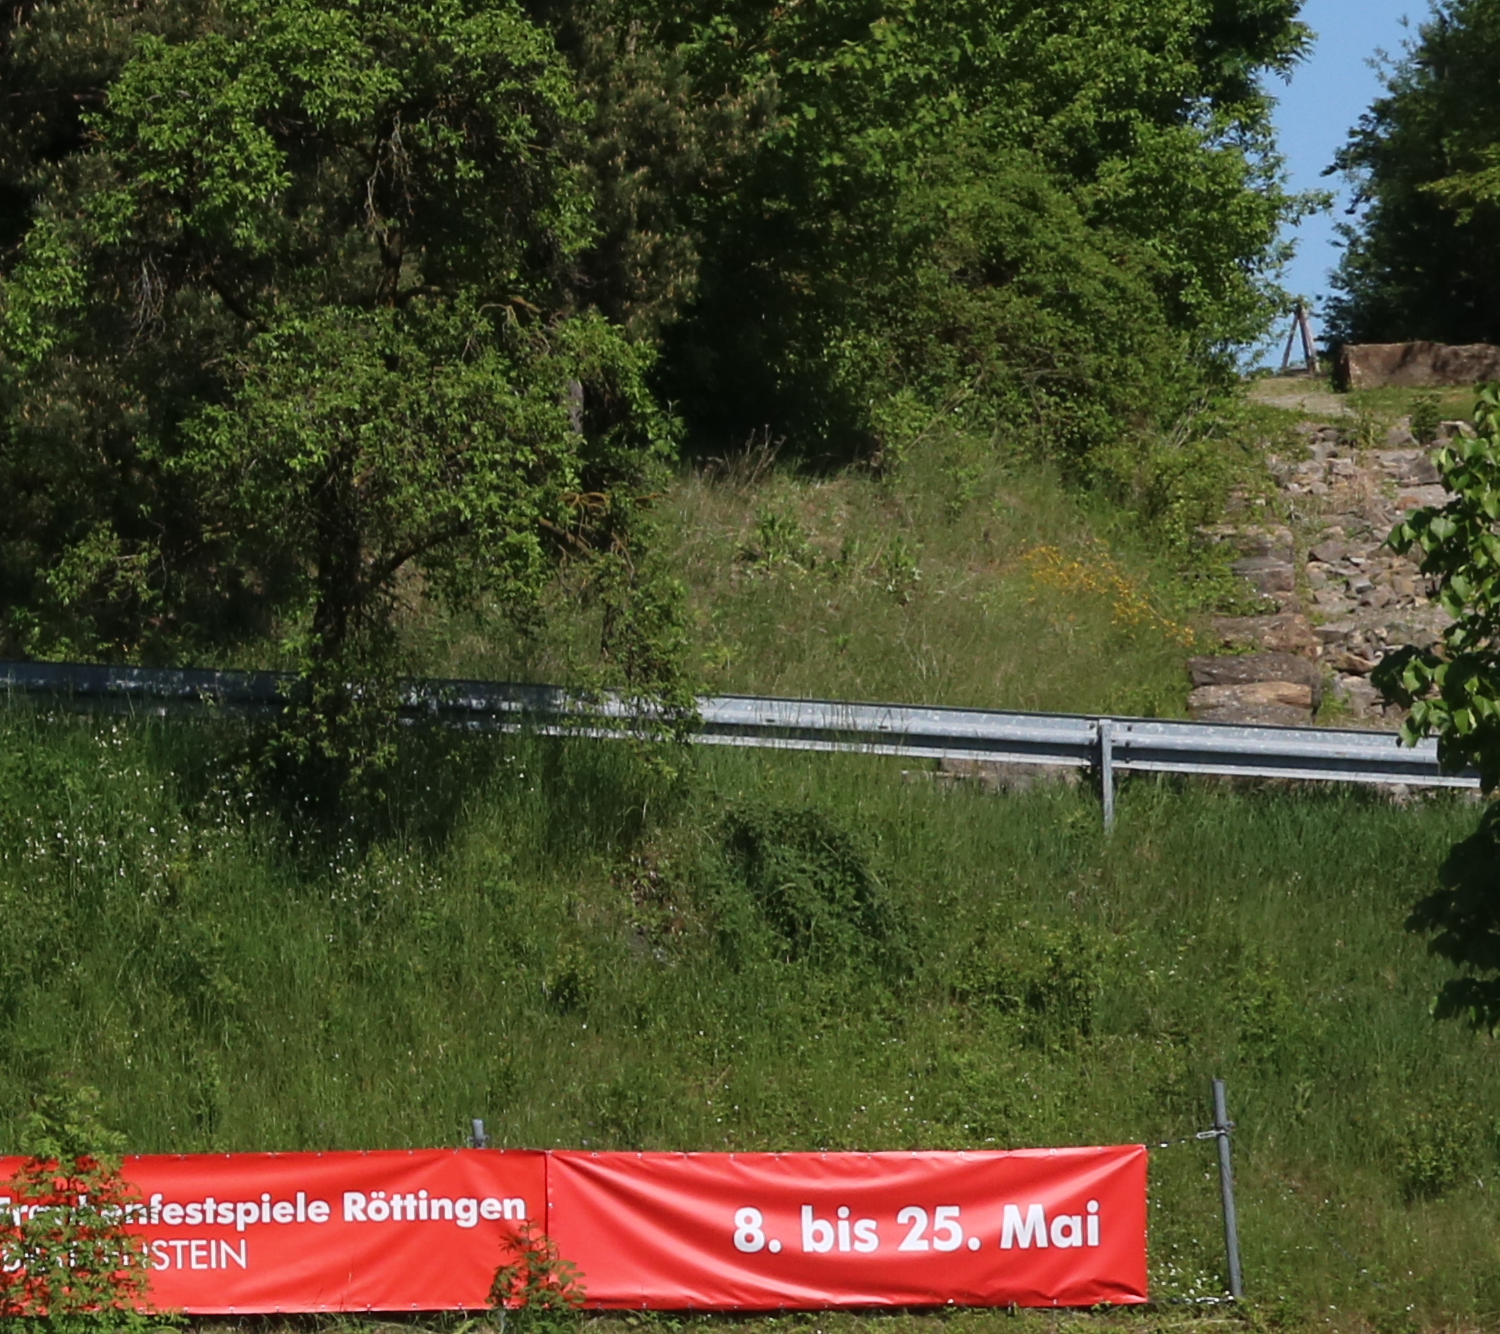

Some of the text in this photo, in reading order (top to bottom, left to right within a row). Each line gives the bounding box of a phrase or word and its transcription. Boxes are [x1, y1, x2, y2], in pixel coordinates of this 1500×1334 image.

[341, 1189, 526, 1229] Röttingen
[732, 1199, 1100, 1254] 8. bis 25. Mai
